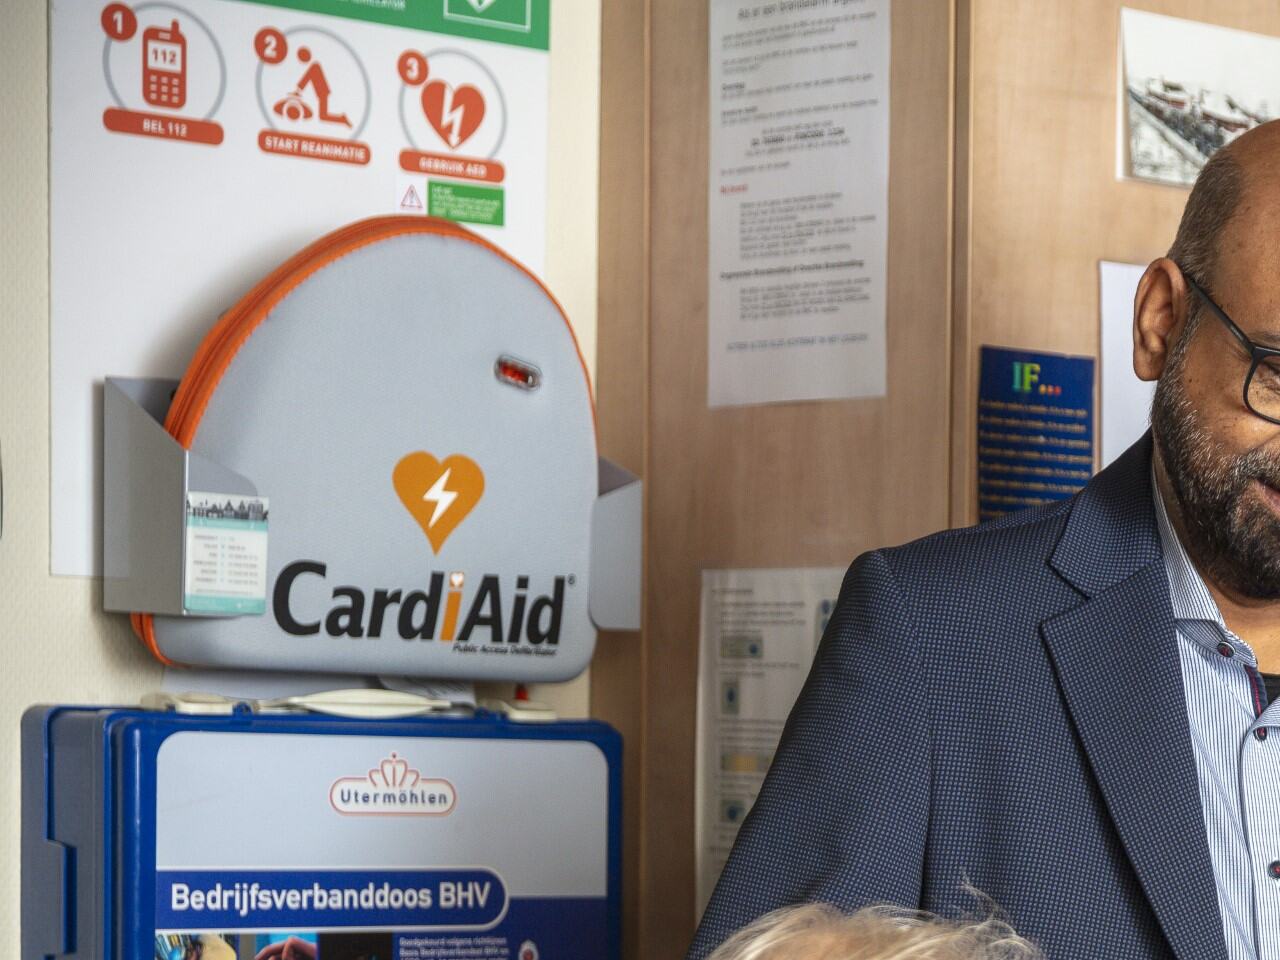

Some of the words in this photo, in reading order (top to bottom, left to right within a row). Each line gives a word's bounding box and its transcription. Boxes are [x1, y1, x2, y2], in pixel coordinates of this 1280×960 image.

[113, 10, 123, 34] 1
[151, 48, 177, 65] 112
[263, 34, 277, 58] 2
[406, 57, 419, 80] 3
[142, 118, 165, 134] BEL
[264, 136, 299, 151] START
[301, 141, 366, 161] REANIMATIE
[272, 559, 566, 646] CardiAid
[340, 788, 448, 805] Utermöhlen
[170, 881, 432, 917] Bedrijfsverbanddoos
[438, 881, 492, 907] BHV
